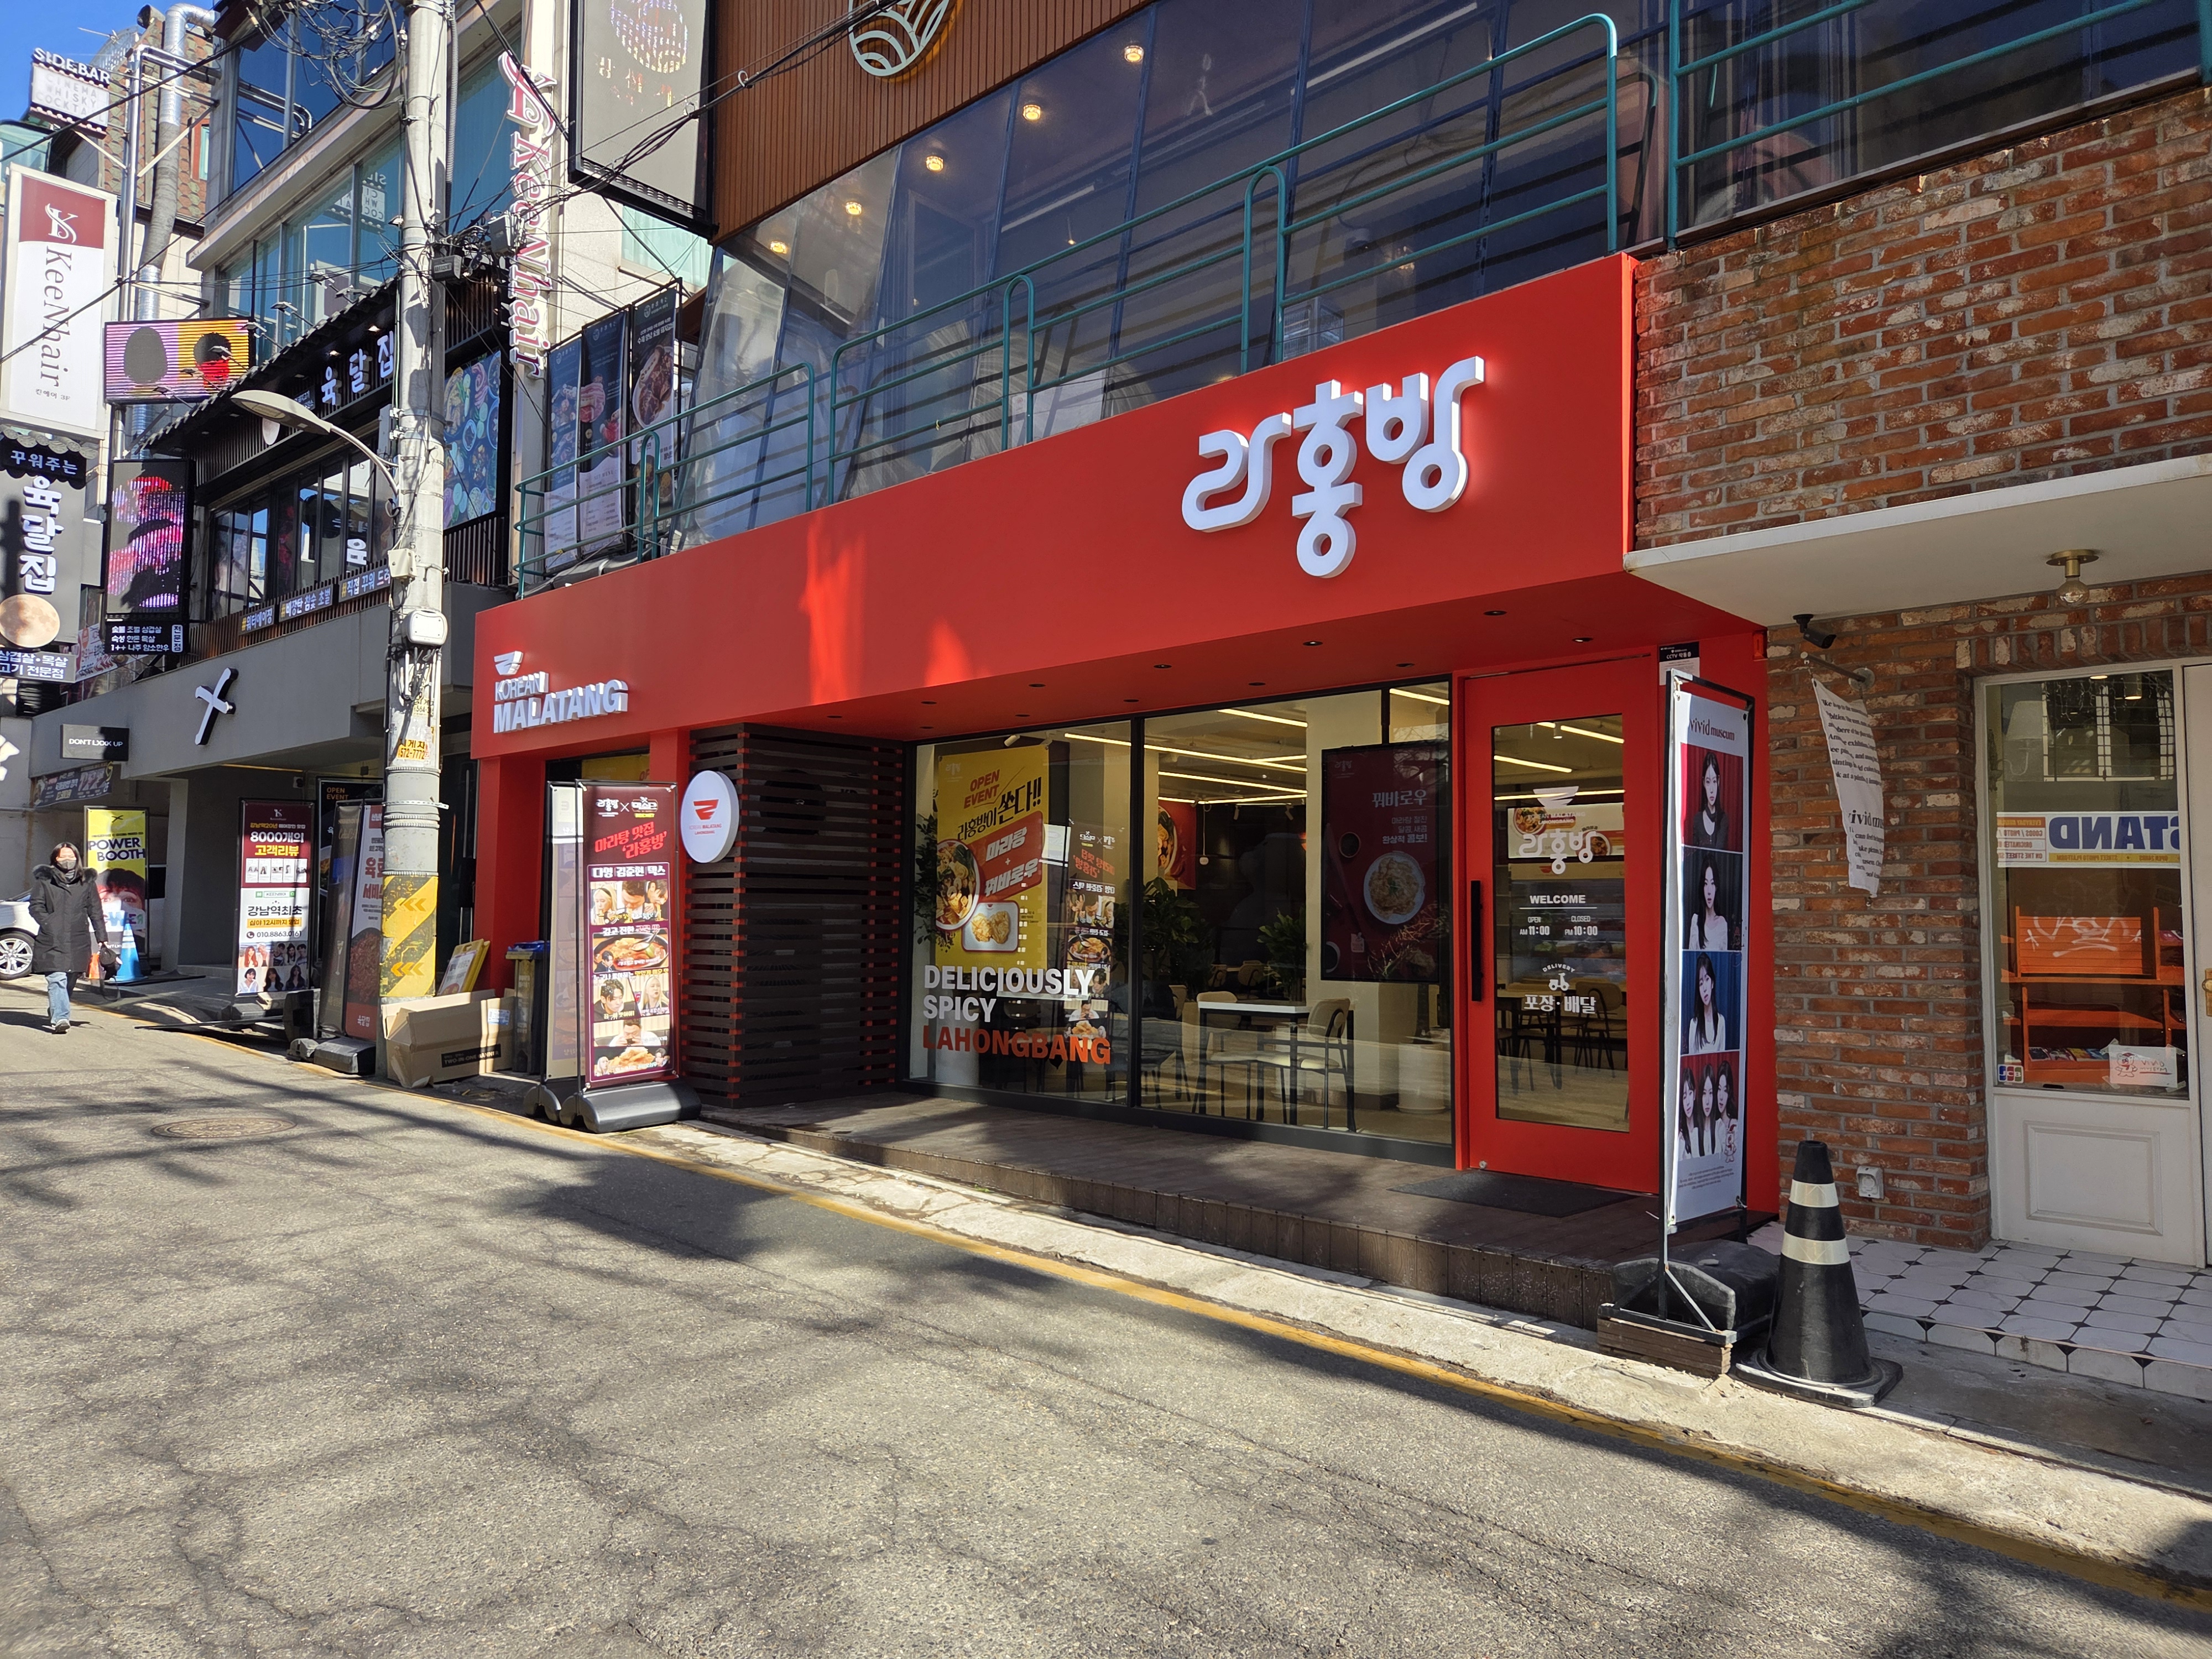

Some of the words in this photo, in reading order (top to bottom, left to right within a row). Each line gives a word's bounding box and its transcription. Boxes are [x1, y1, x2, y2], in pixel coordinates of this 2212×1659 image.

[33, 47, 110, 85] SIDEBAR
[46, 74, 96, 98] CINEMA
[46, 85, 96, 108] WHISKY
[36, 92, 104, 122] COCKTAL
[321, 331, 394, 405] 육달집
[11, 450, 78, 475] 꾸워주는
[1182, 356, 1484, 578] 라홍방
[19, 476, 64, 594] 육달집
[27, 665, 64, 680] 전문점
[495, 671, 549, 701] KOREAN
[494, 680, 628, 733] MALATANG
[1689, 718, 1710, 736] vivid
[1710, 727, 1734, 741] museum
[970, 769, 1000, 792] OPEN
[963, 784, 1000, 809] EVENT
[957, 807, 997, 841] 라홍방이
[88, 837, 141, 850] POWER
[250, 831, 304, 843] 8000개의
[594, 830, 630, 853] 마라탕
[632, 821, 655, 841] 맛집
[97, 848, 145, 862] BOOTH
[254, 845, 299, 857] 고객리뷰
[1519, 828, 1597, 875] 라홍방
[592, 867, 613, 878] 다영
[248, 905, 302, 916] 강남역최초
[1530, 895, 1586, 904] WELCOME
[1528, 926, 1550, 936] 11:00
[1574, 926, 1598, 936] 10:00
[1542, 963, 1575, 973] DELIVERY
[924, 965, 1095, 995] DELICIOUSLY
[923, 995, 997, 1022] SPICY
[1524, 994, 1555, 1011] 포장
[1564, 996, 1597, 1014] 배달
[923, 1025, 1111, 1065] LAHONGBANG
[1999, 1067, 2023, 1081] JCB
